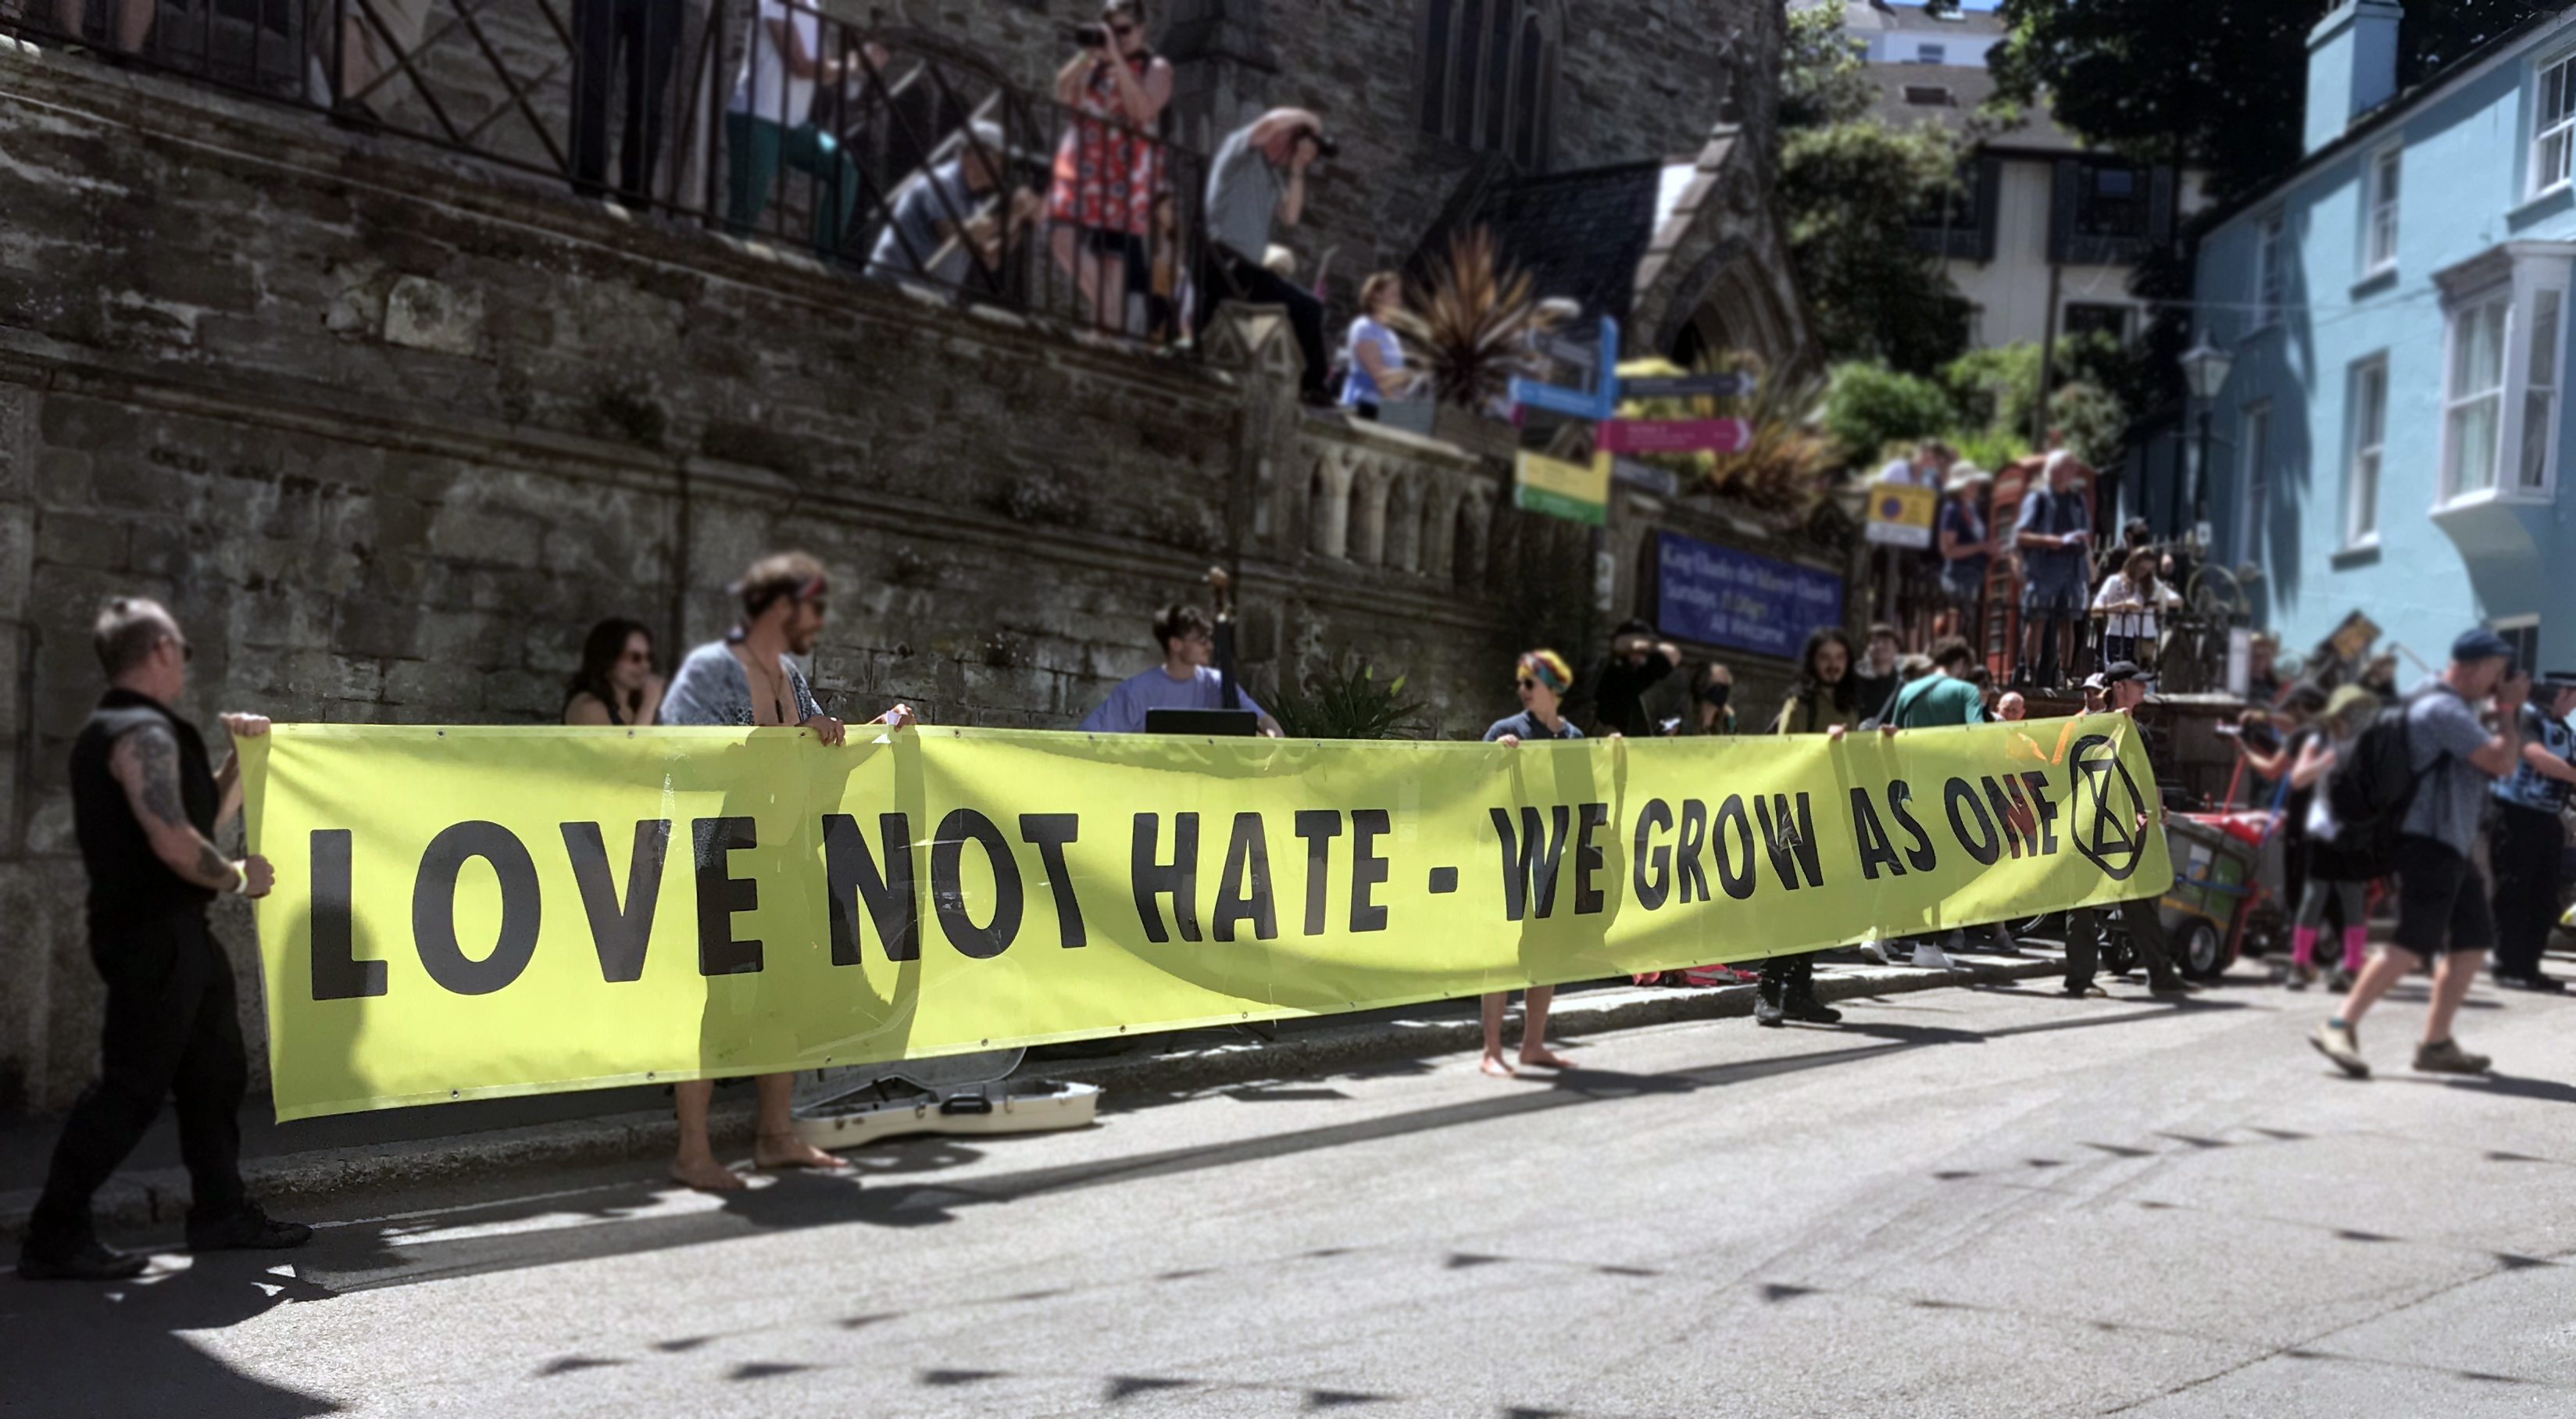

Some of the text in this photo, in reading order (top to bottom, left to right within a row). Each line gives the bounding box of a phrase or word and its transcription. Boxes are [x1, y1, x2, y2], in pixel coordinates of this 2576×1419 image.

[310, 770, 2058, 1000] LOVE NOT HATE - WE GROW AS ONE
